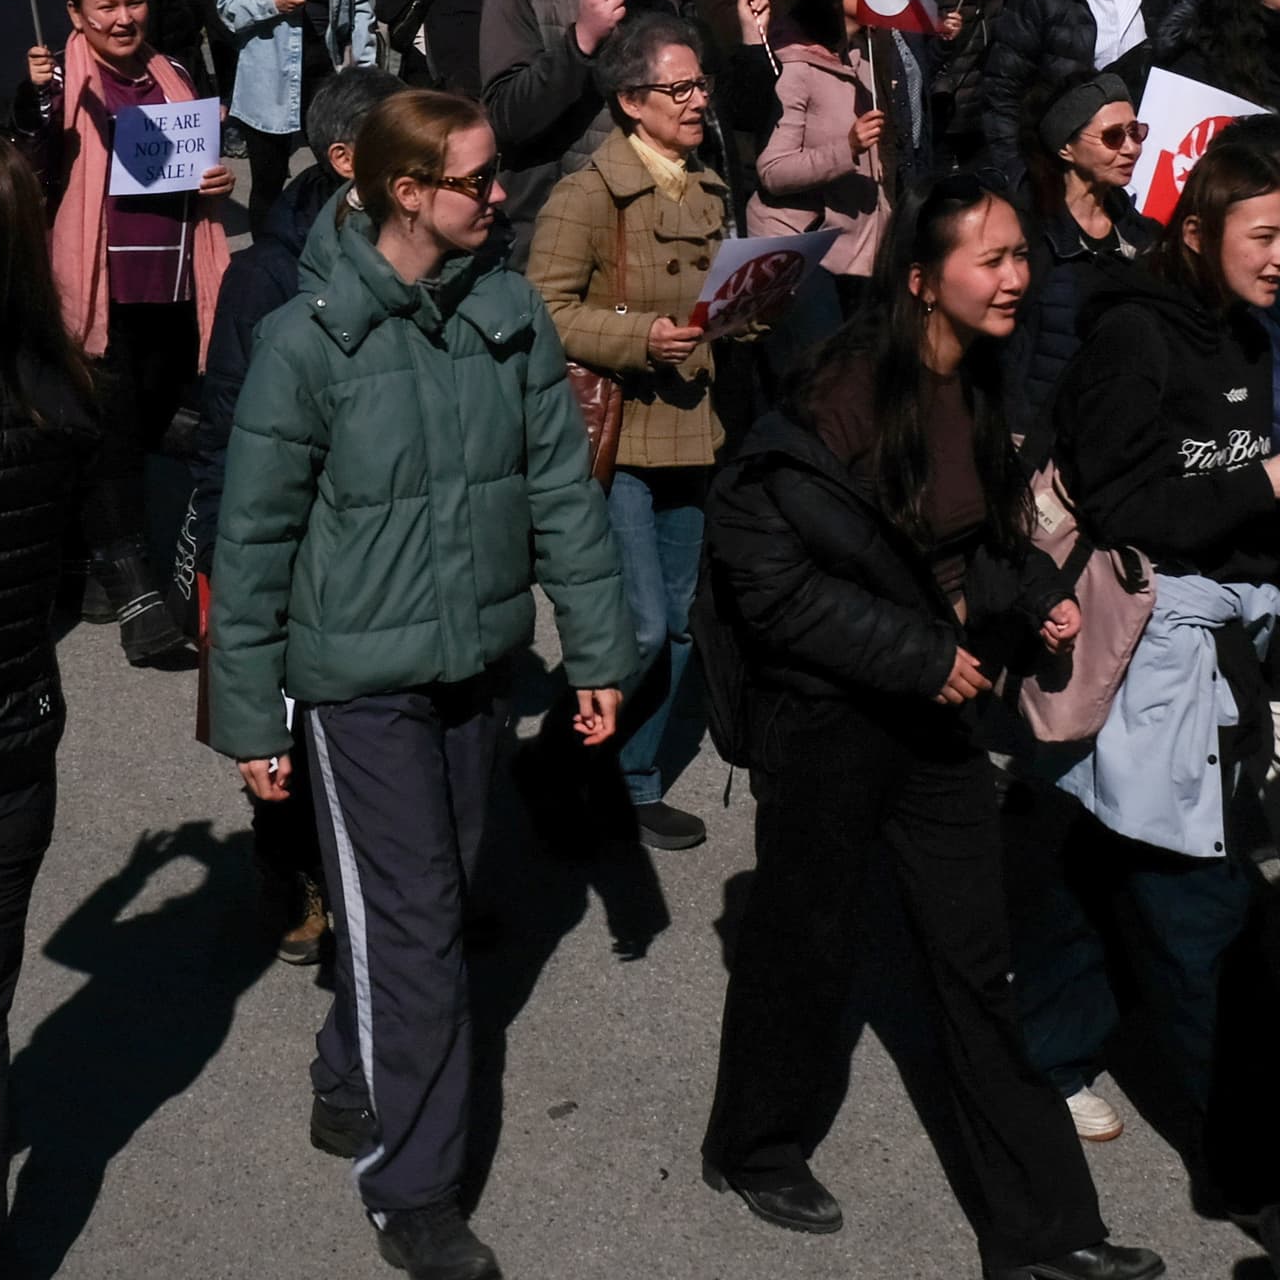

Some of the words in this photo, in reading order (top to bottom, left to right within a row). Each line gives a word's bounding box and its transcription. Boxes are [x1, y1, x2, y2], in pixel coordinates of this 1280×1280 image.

[143, 117, 168, 132] WE
[171, 113, 201, 131] ARE
[134, 141, 173, 158] NOT
[176, 138, 206, 155] FOR
[146, 163, 185, 181] SALE
